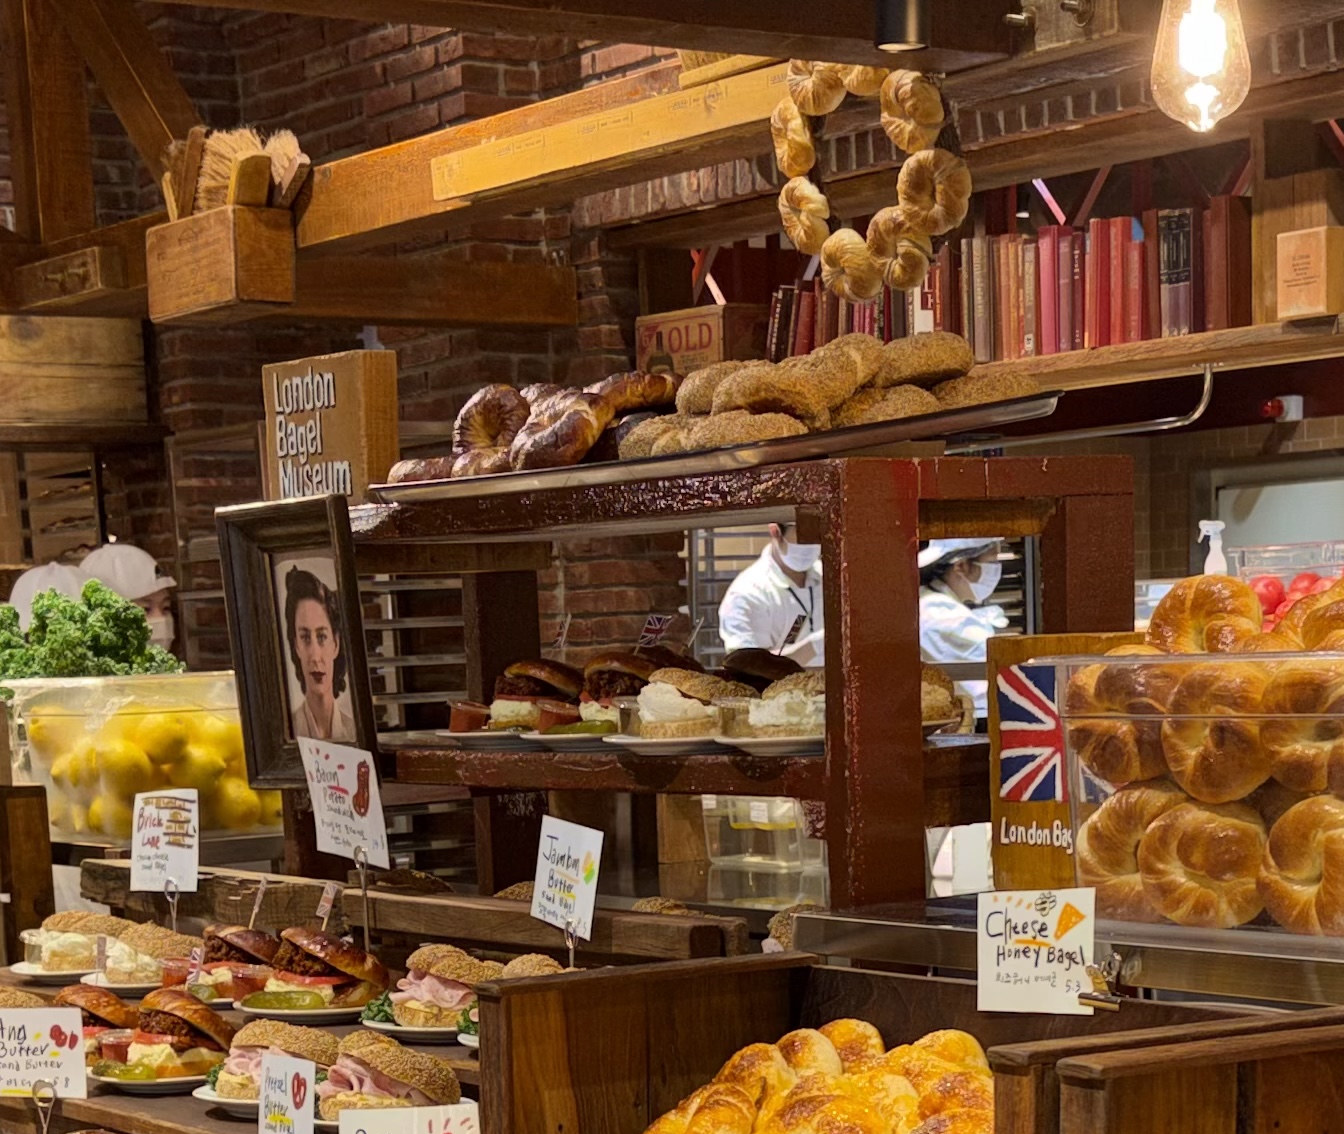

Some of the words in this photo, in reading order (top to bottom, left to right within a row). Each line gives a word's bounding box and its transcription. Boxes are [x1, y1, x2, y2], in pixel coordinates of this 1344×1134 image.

[668, 323, 713, 354] OLD
[273, 366, 336, 415] London
[276, 411, 323, 465] Bagel
[279, 458, 353, 500] Museum
[137, 806, 163, 833] Brick
[1000, 816, 1051, 846] London
[548, 867, 574, 894] Butter
[986, 907, 1049, 945] Cheese
[997, 945, 1041, 969] Honey
[1047, 944, 1086, 972] Bagel
[1065, 978, 1081, 993] 5.3
